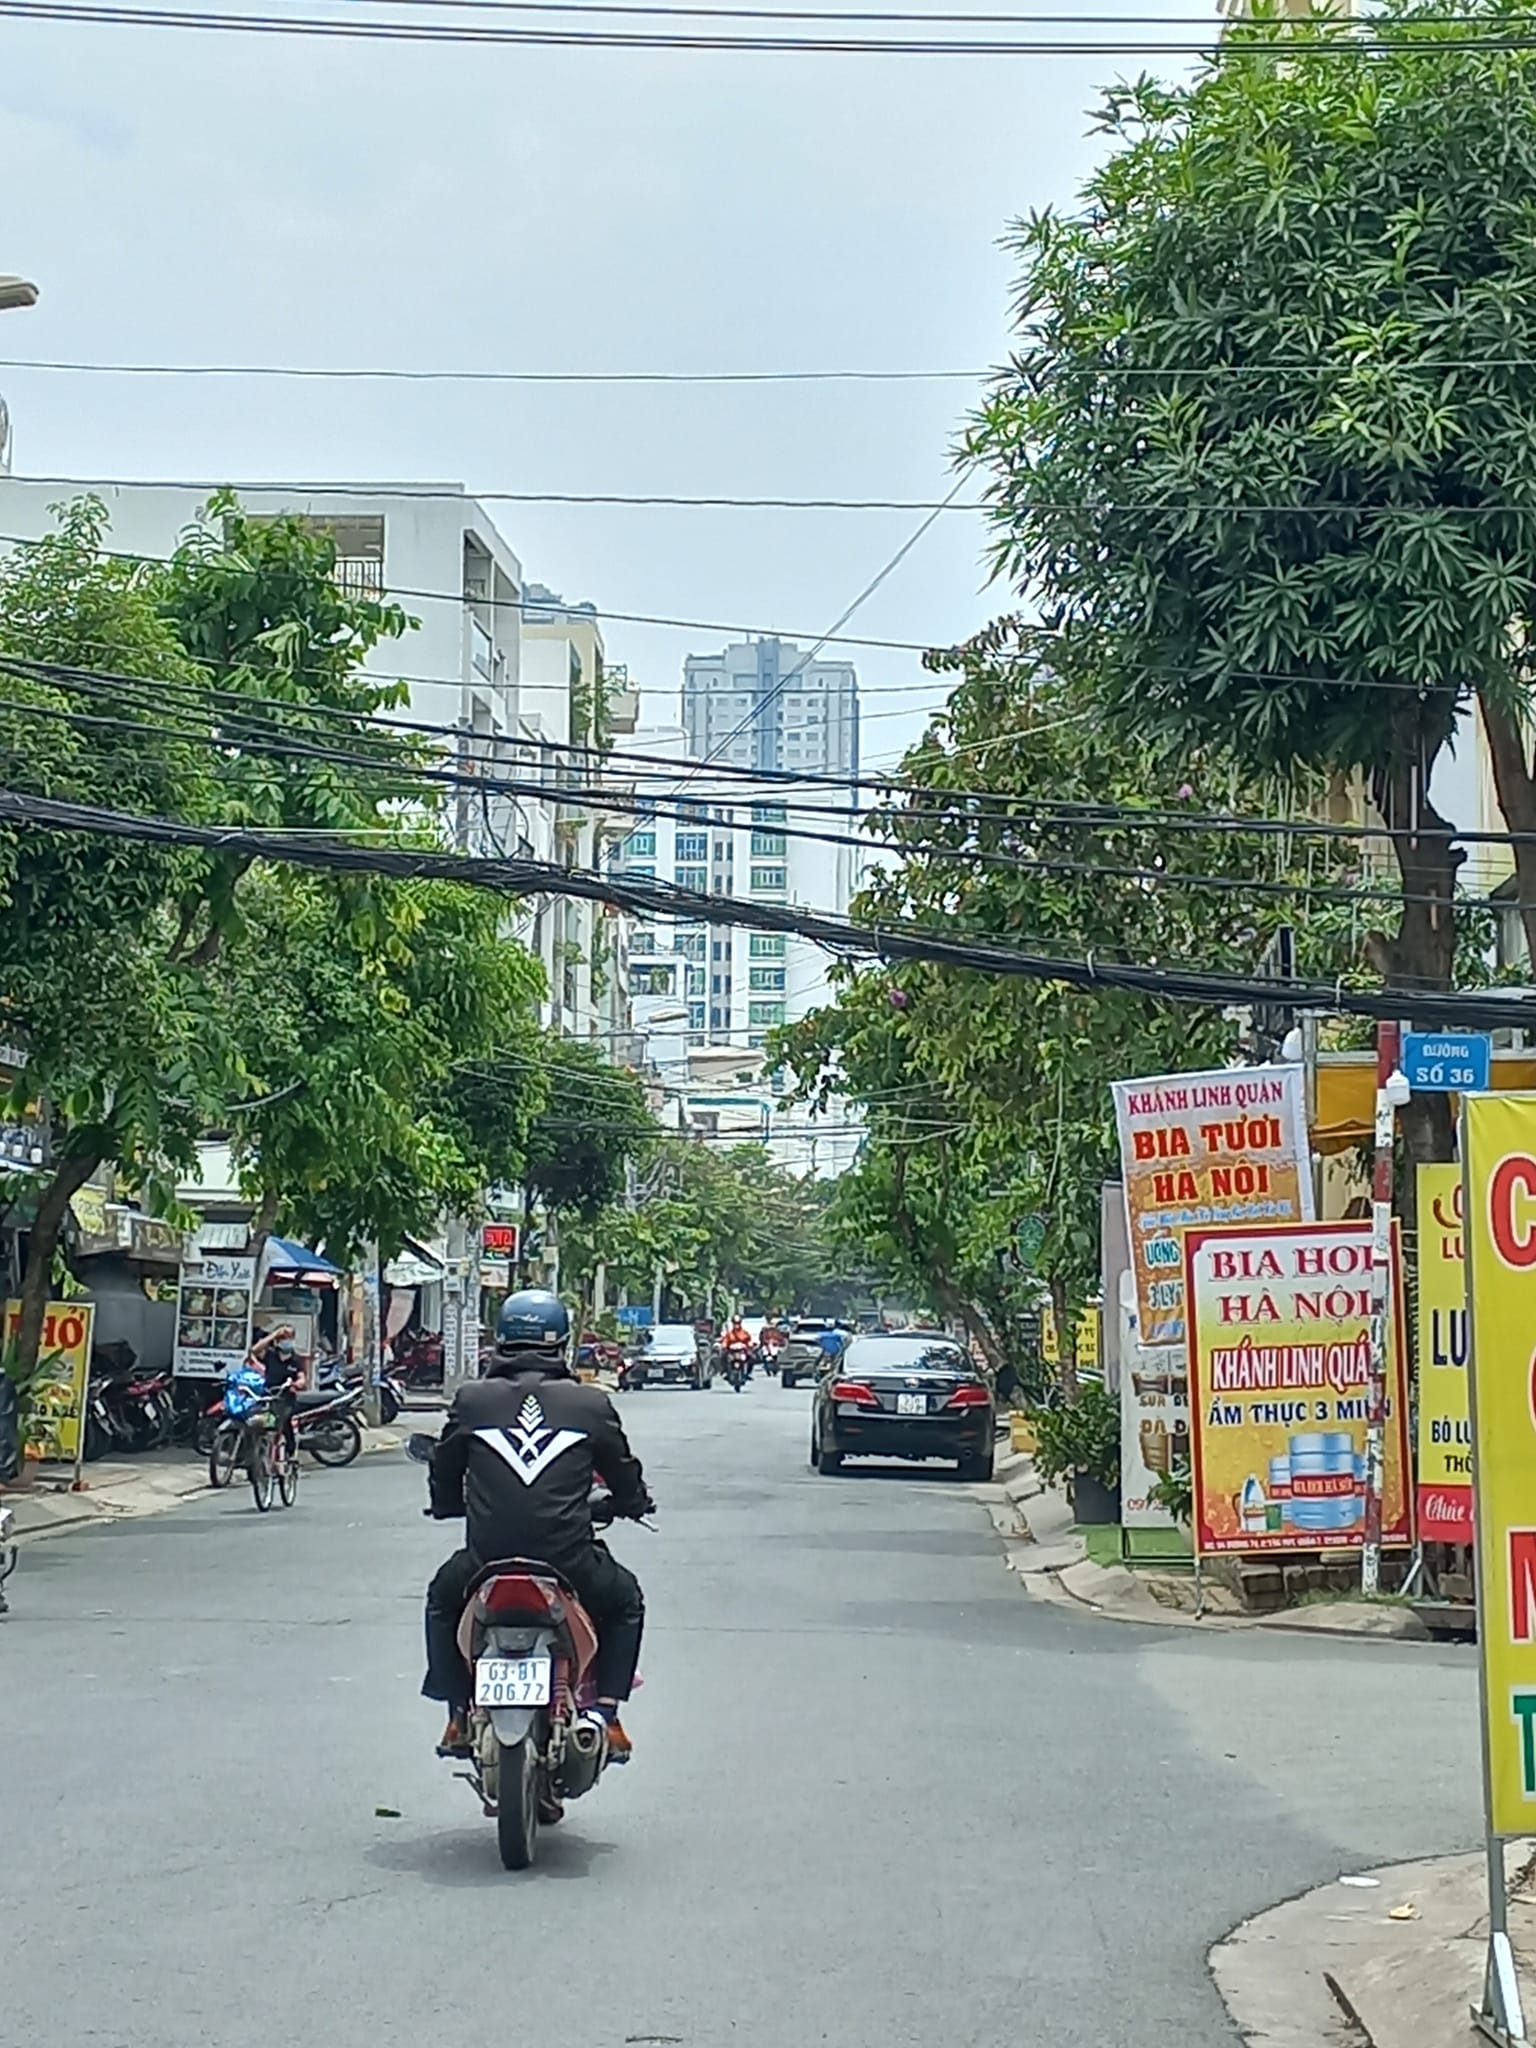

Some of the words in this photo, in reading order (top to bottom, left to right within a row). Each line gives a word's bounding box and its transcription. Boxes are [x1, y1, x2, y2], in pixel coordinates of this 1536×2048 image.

[1416, 1062, 1444, 1083] SỐ
[1128, 1085, 1188, 1116] KHÁNH
[1192, 1086, 1231, 1108] LINH
[1132, 1127, 1191, 1160] BIA
[1200, 1113, 1282, 1152] TƯƠI
[1211, 1159, 1269, 1201] NỘI
[1209, 1249, 1284, 1281] BIA
[1217, 1287, 1282, 1326] HÀ
[1291, 1284, 1372, 1325] NỘI
[1211, 1336, 1278, 1390] KHÁNH
[1282, 1346, 1326, 1388] LINH
[1327, 1332, 1370, 1394] QUÁ
[1208, 1394, 1242, 1426] ẨM
[1314, 1400, 1328, 1421] 3
